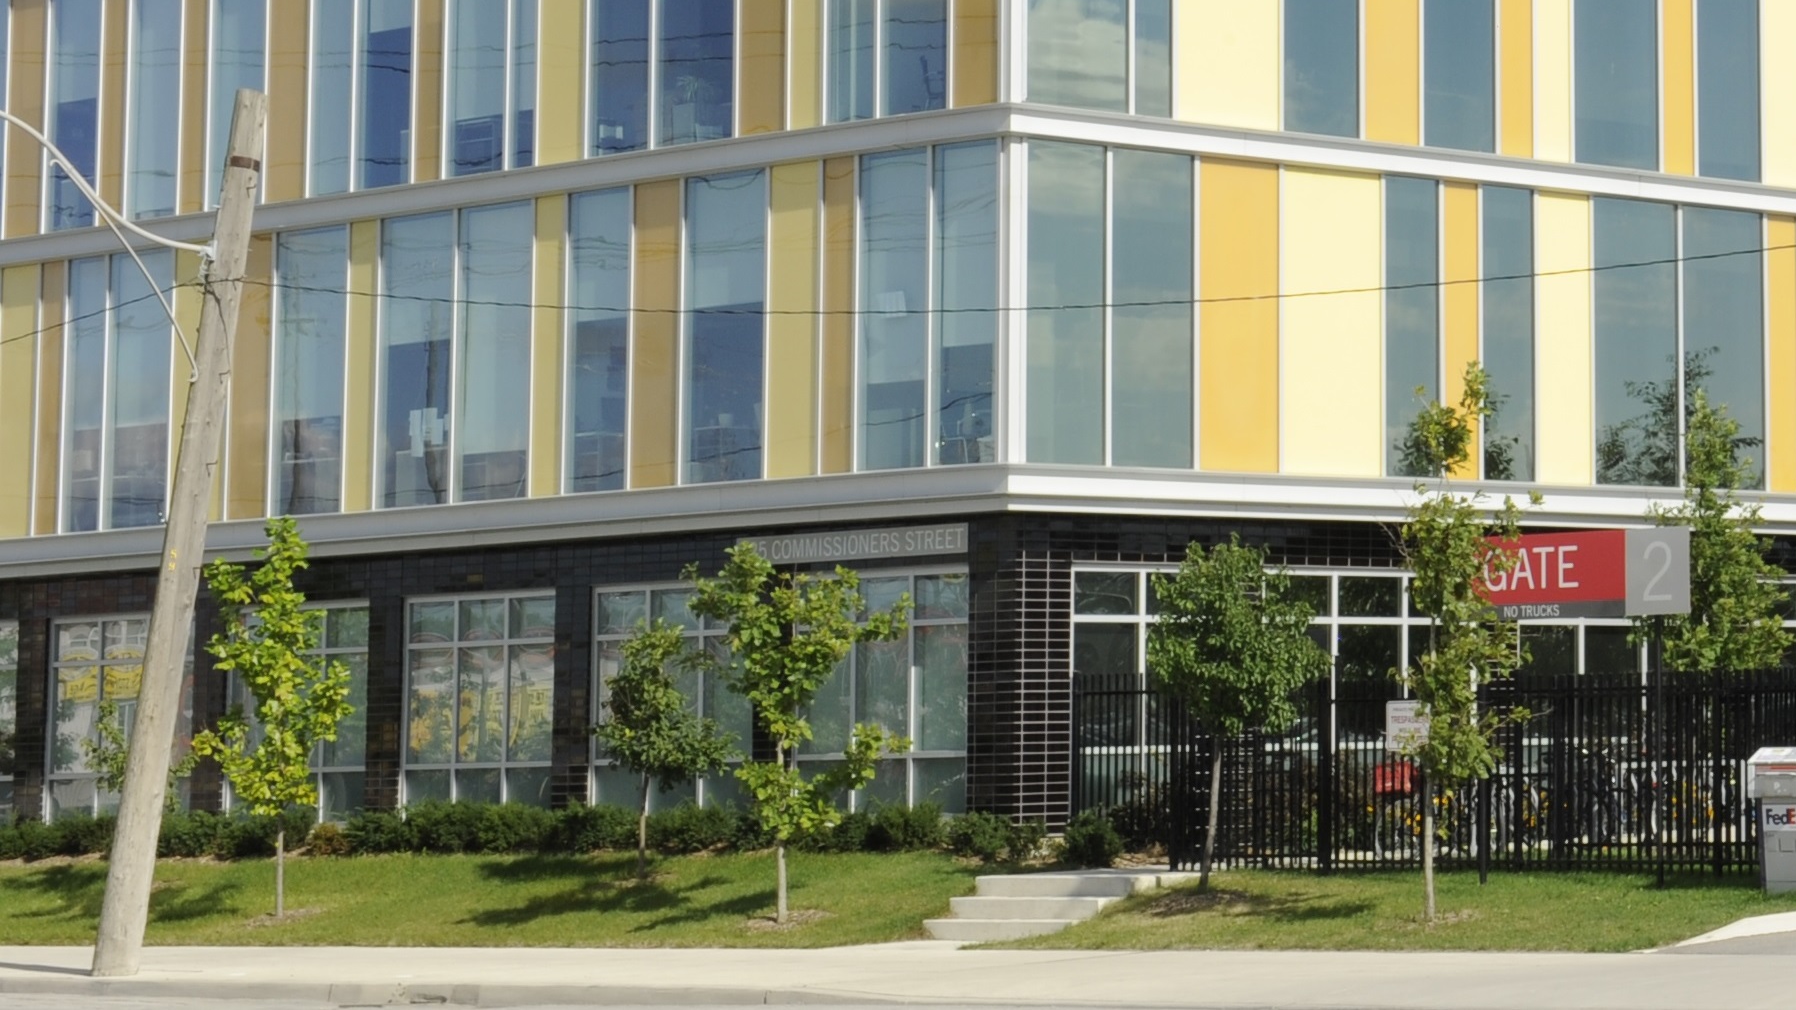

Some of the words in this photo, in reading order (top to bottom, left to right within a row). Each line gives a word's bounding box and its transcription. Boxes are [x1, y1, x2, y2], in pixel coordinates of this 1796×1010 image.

[772, 532, 900, 559] COMMISSIONERS
[905, 527, 965, 552] STREET
[1483, 545, 1579, 592] GATE
[1643, 541, 1673, 601] 2
[1503, 606, 1518, 618] NO
[1520, 604, 1560, 617] TRUCKS
